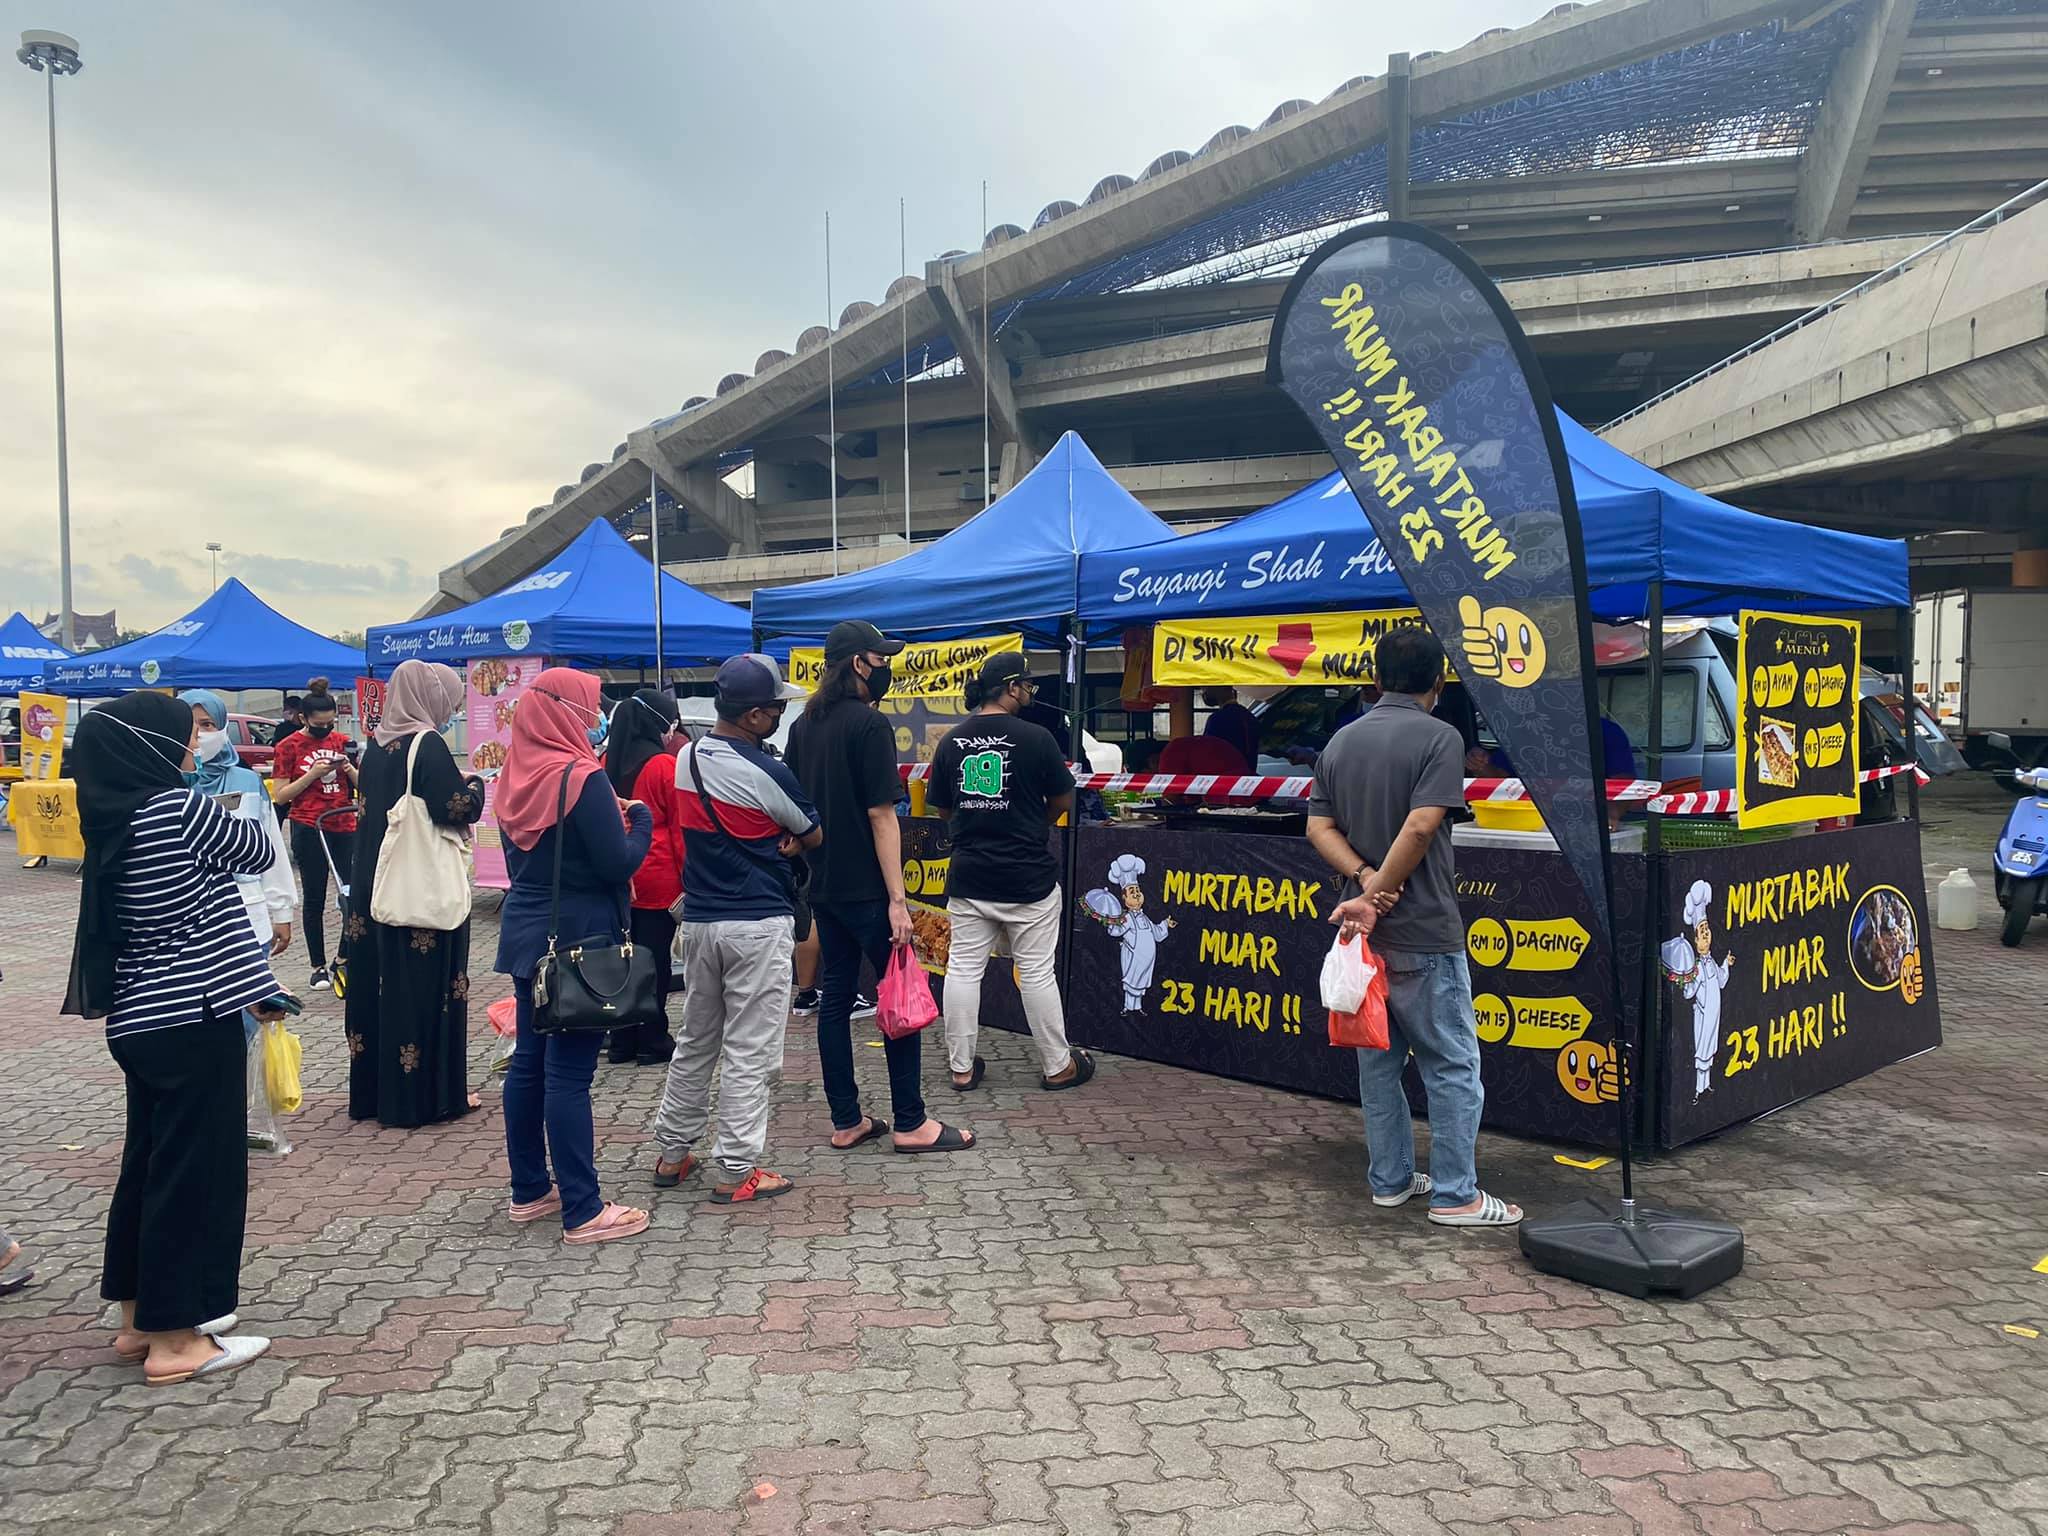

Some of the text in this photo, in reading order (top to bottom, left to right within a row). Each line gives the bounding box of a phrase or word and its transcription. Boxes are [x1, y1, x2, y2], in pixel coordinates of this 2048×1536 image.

[1113, 562, 1228, 606] Sayangi
[1242, 541, 1325, 589] Shah
[381, 625, 490, 656] Sayangi Shah Alam
[1164, 636, 1185, 662] DI
[1192, 638, 1237, 662] SINI
[1784, 644, 1821, 656] MENU
[796, 660, 809, 681] DI
[905, 645, 988, 673] ROTI JOHN
[1322, 650, 1375, 680] MUA
[0, 677, 24, 690] ngi
[953, 668, 982, 692] HA
[1772, 673, 1793, 691] AYAM
[1821, 675, 1844, 691] DAGING
[1821, 735, 1843, 749] CHEESE
[303, 749, 338, 765] BATHI
[960, 750, 1003, 798] 19
[914, 870, 919, 880] 7
[926, 866, 949, 882] AYA
[1454, 873, 1497, 897] enu
[1162, 869, 1322, 920] MURTABAK
[1725, 861, 1851, 931] MURTABAK
[1200, 928, 1281, 976] MUAR
[1470, 930, 1584, 954] RM 10 DAGING
[1762, 935, 1829, 993] MUAR
[1160, 979, 1301, 1034] 23 HARI !!
[1494, 1011, 1507, 1027] 15
[1517, 1007, 1582, 1031] CHEESE
[1724, 991, 1847, 1078] 23 HARI !!
